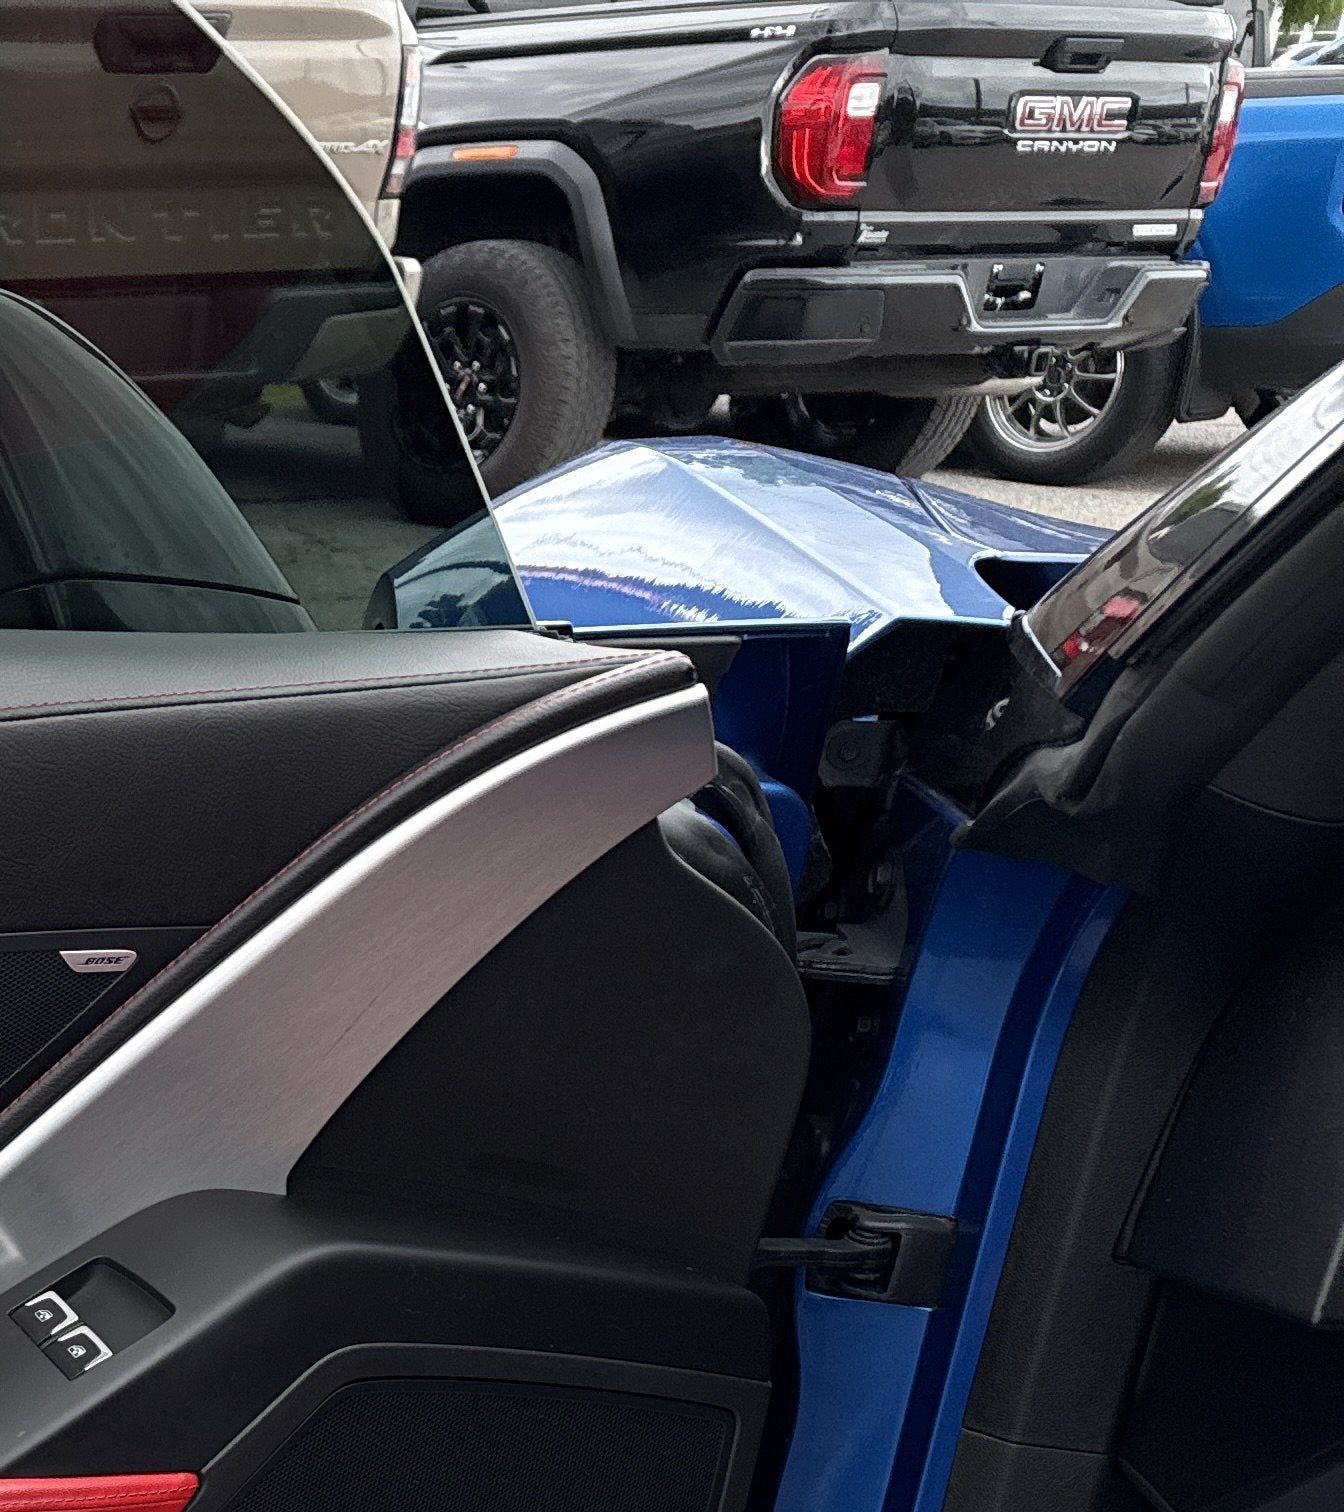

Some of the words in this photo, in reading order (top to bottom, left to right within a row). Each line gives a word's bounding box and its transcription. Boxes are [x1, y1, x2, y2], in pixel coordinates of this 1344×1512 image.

[1015, 95, 1132, 131] GMC
[1015, 140, 1117, 152] CANYON
[78, 956, 130, 966] BOSE
